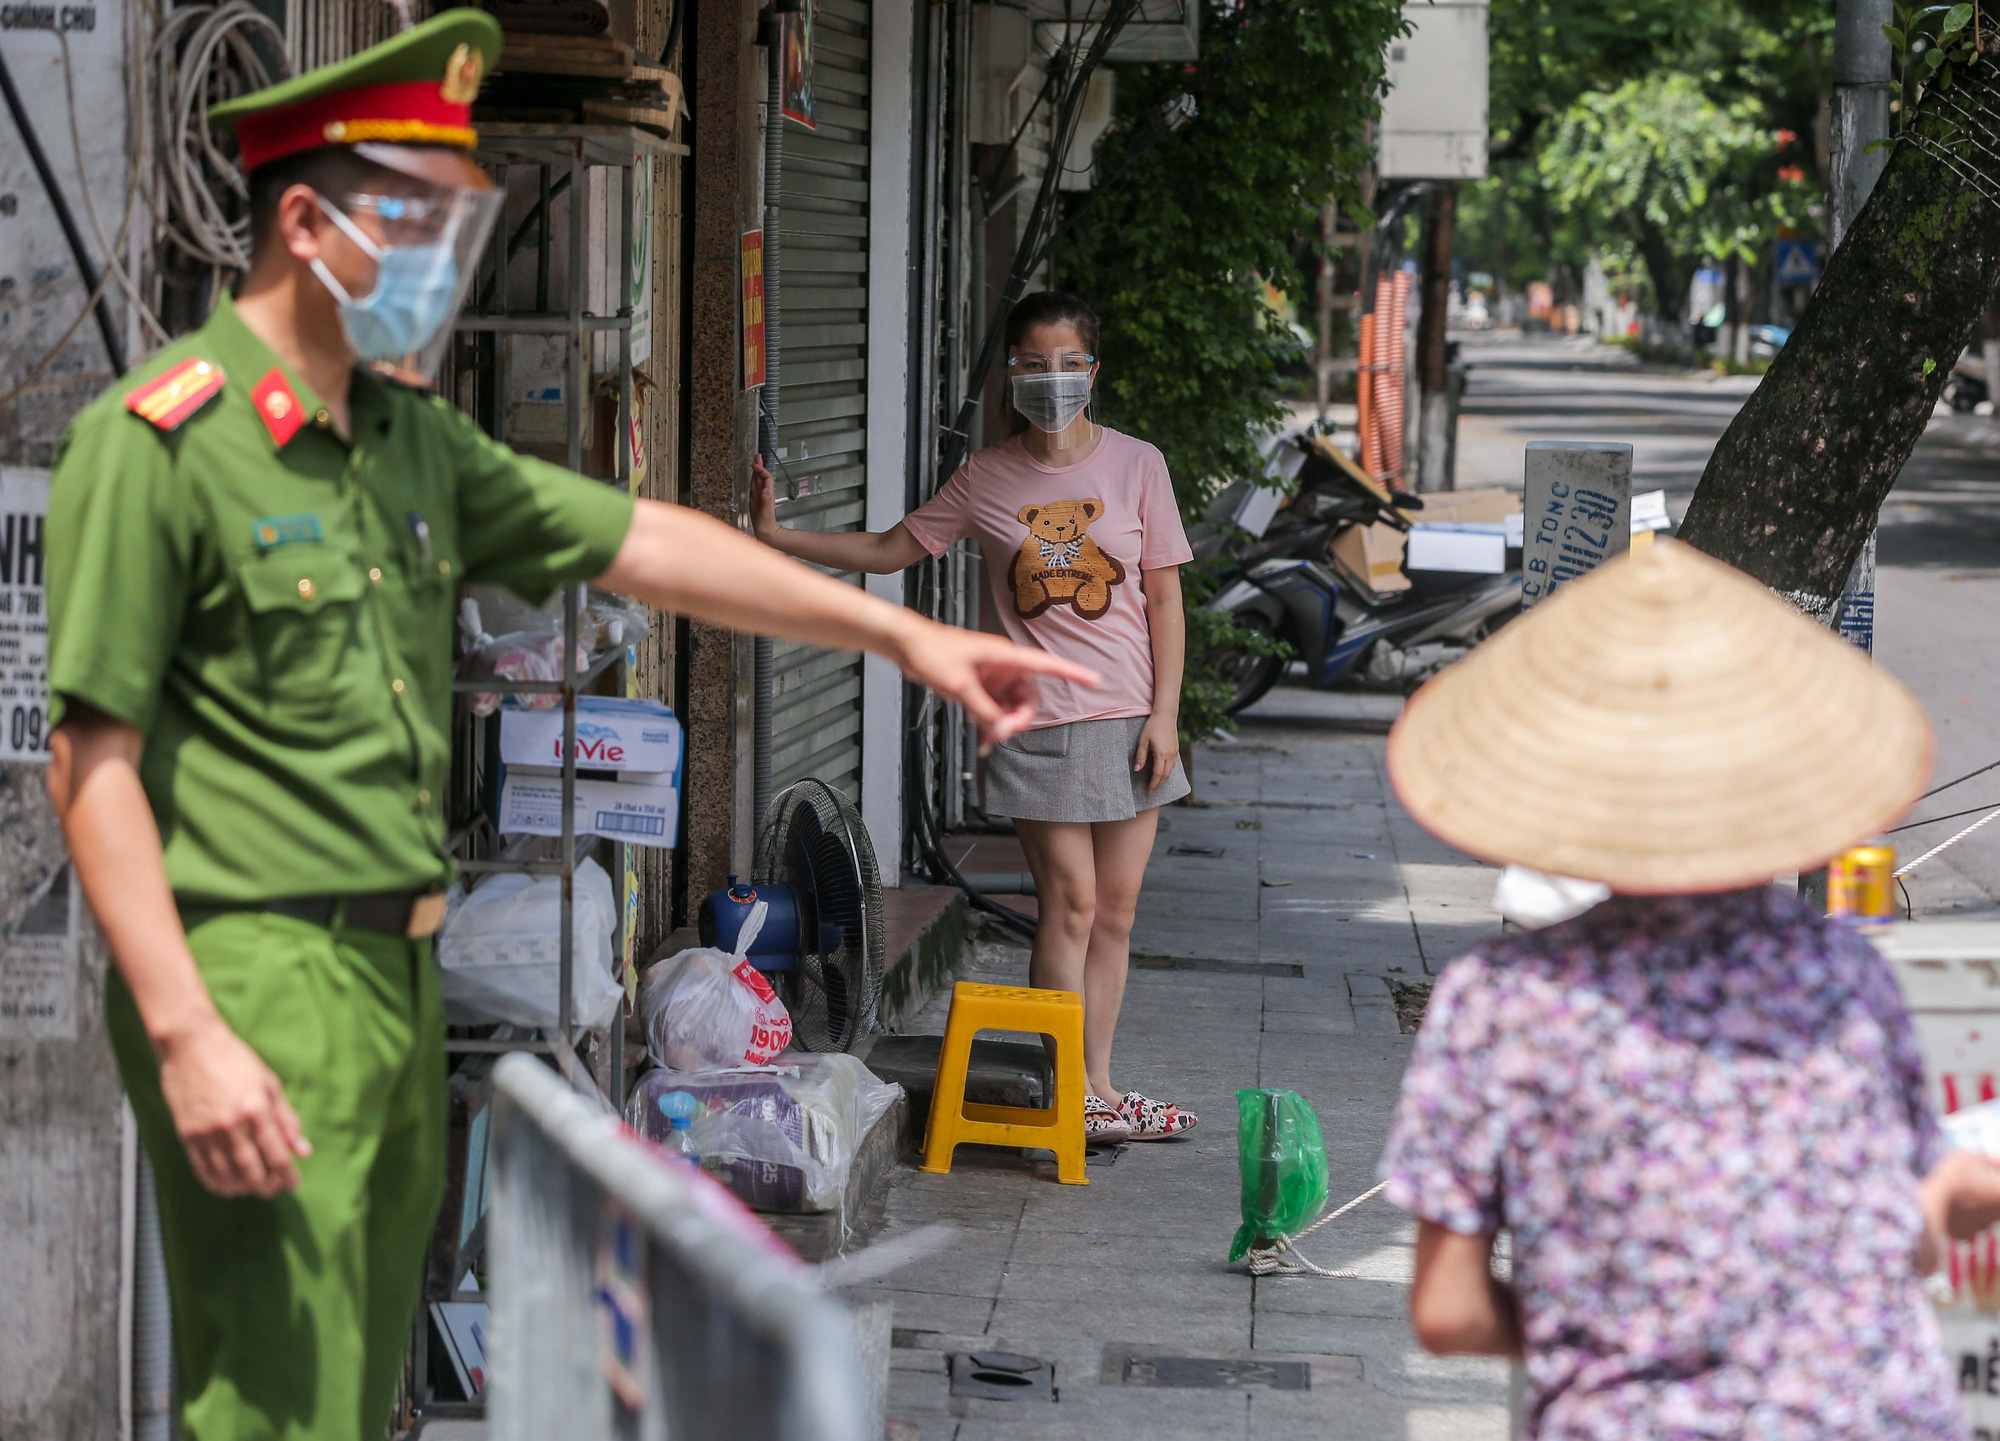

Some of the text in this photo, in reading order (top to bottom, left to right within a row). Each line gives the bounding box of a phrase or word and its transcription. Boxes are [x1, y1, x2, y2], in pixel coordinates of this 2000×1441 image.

[1030, 569, 1094, 583] MADE EXTREME
[762, 1162, 778, 1184] 25
